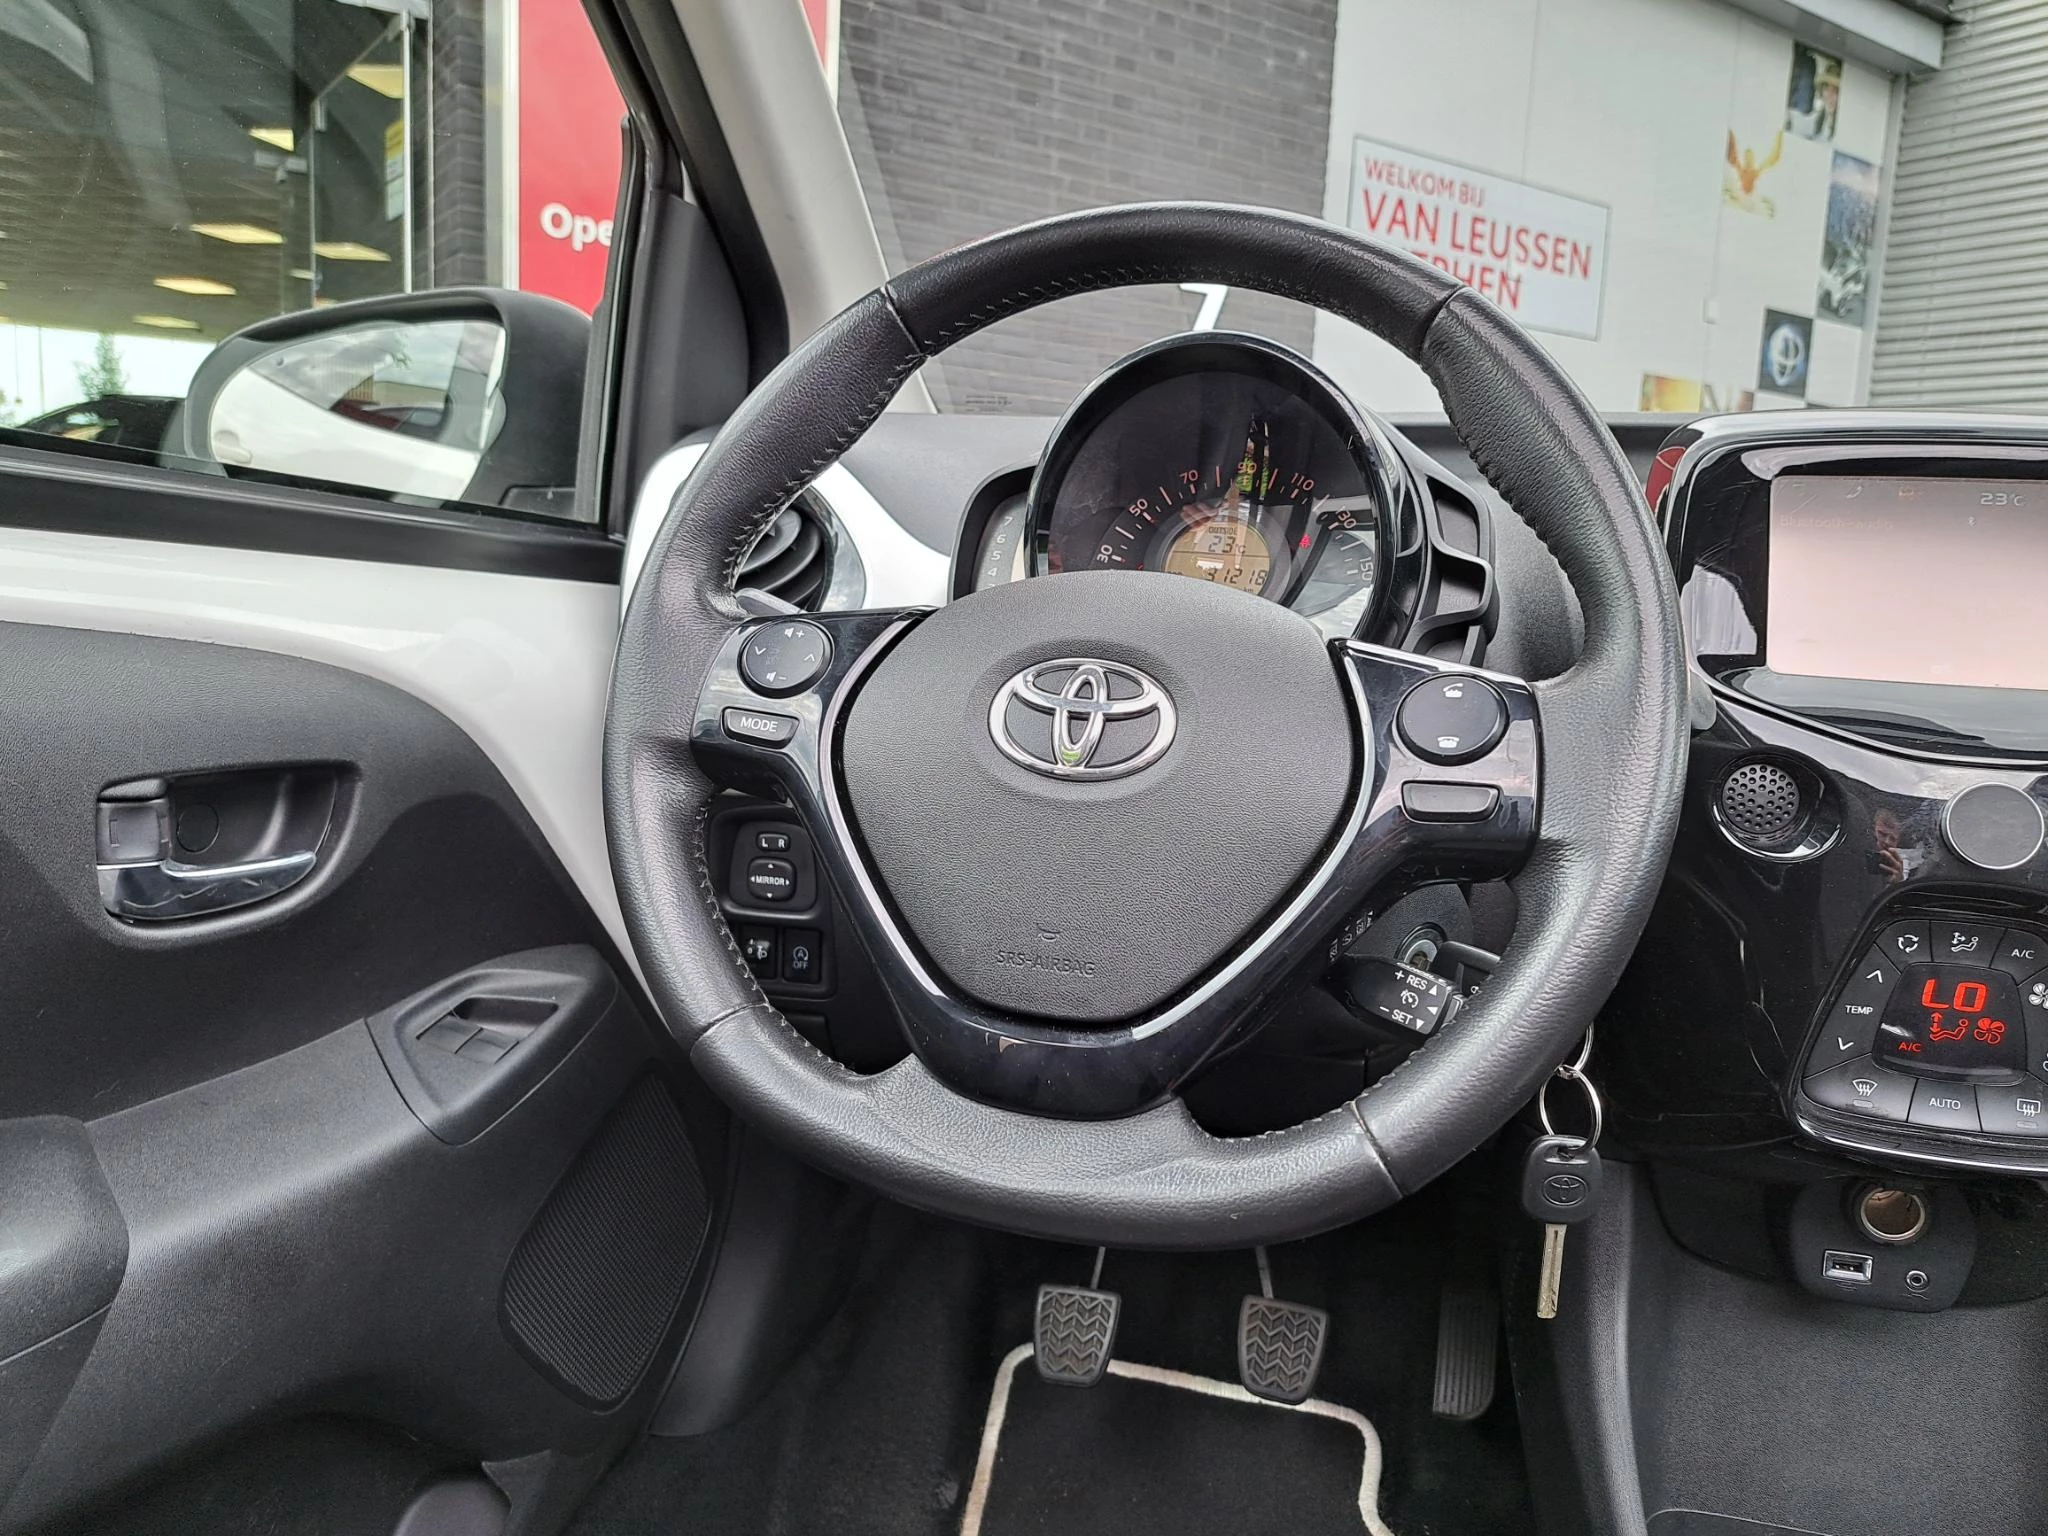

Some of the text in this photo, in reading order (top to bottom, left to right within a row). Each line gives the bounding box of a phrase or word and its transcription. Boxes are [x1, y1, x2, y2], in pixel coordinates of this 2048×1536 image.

[1364, 157, 1455, 200] WELKOM
[1363, 188, 1592, 281] VAN LEUSSEN
[1237, 461, 1258, 475] 90
[1180, 469, 1199, 485] 70
[1290, 471, 1315, 492] 110
[1129, 498, 1149, 518] 50
[1003, 516, 1013, 527] 7
[1335, 505, 1357, 529] 130
[1207, 526, 1238, 536] OUTSIDE
[996, 534, 1006, 545] 6
[991, 551, 1001, 562] 5
[1096, 544, 1113, 564] 30
[987, 567, 998, 578] 4
[1359, 556, 1375, 582] 150
[740, 716, 778, 733] MODE
[761, 839, 786, 849] L R
[755, 875, 786, 887] MIRROR
[2011, 948, 2036, 960] A/C
[793, 960, 809, 969] OFF
[1406, 974, 1428, 991] RES
[1921, 978, 1988, 1013] LO
[1845, 1004, 1874, 1016] TEMP
[1391, 1009, 1414, 1026] SET
[1898, 1041, 1923, 1053] A/C
[1929, 1097, 1962, 1110] AUTO
